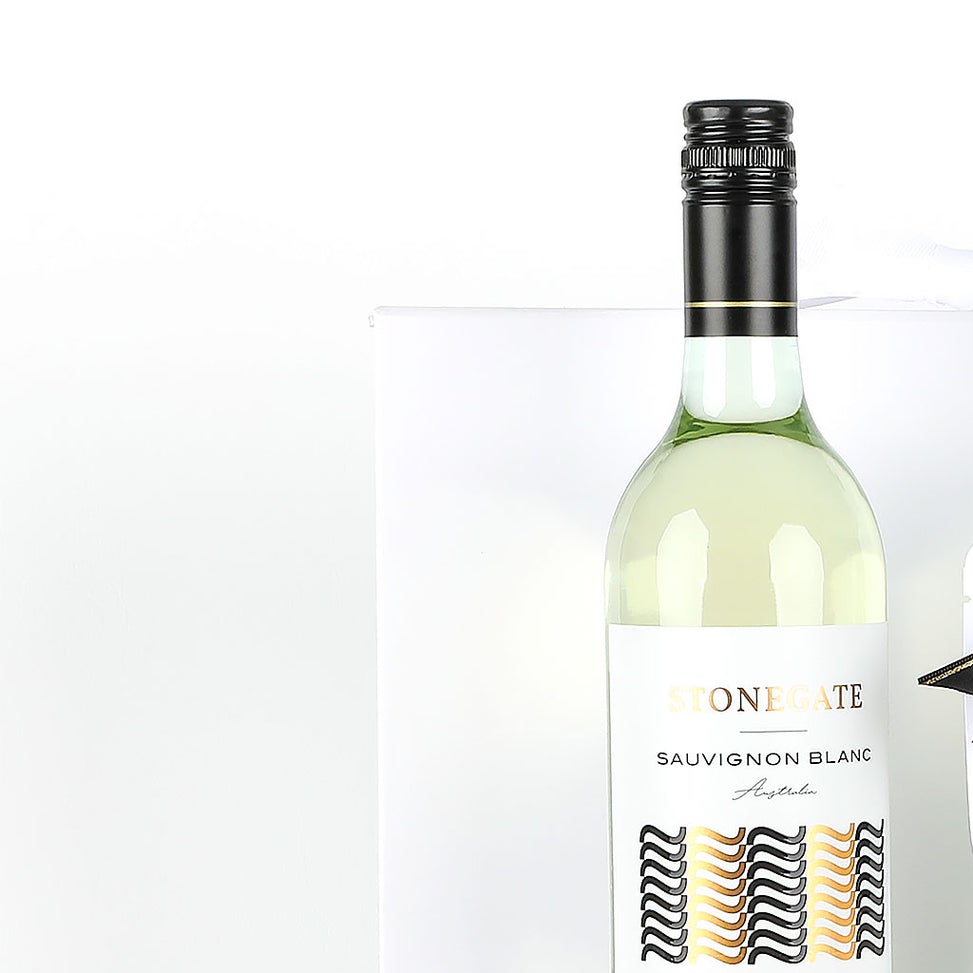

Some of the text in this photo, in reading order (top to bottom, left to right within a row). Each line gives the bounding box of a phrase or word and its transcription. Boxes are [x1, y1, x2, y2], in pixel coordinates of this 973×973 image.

[668, 682, 864, 713] STONEGATE
[656, 747, 872, 767] SAUVIGNON BLANC
[732, 777, 818, 800] Australia
